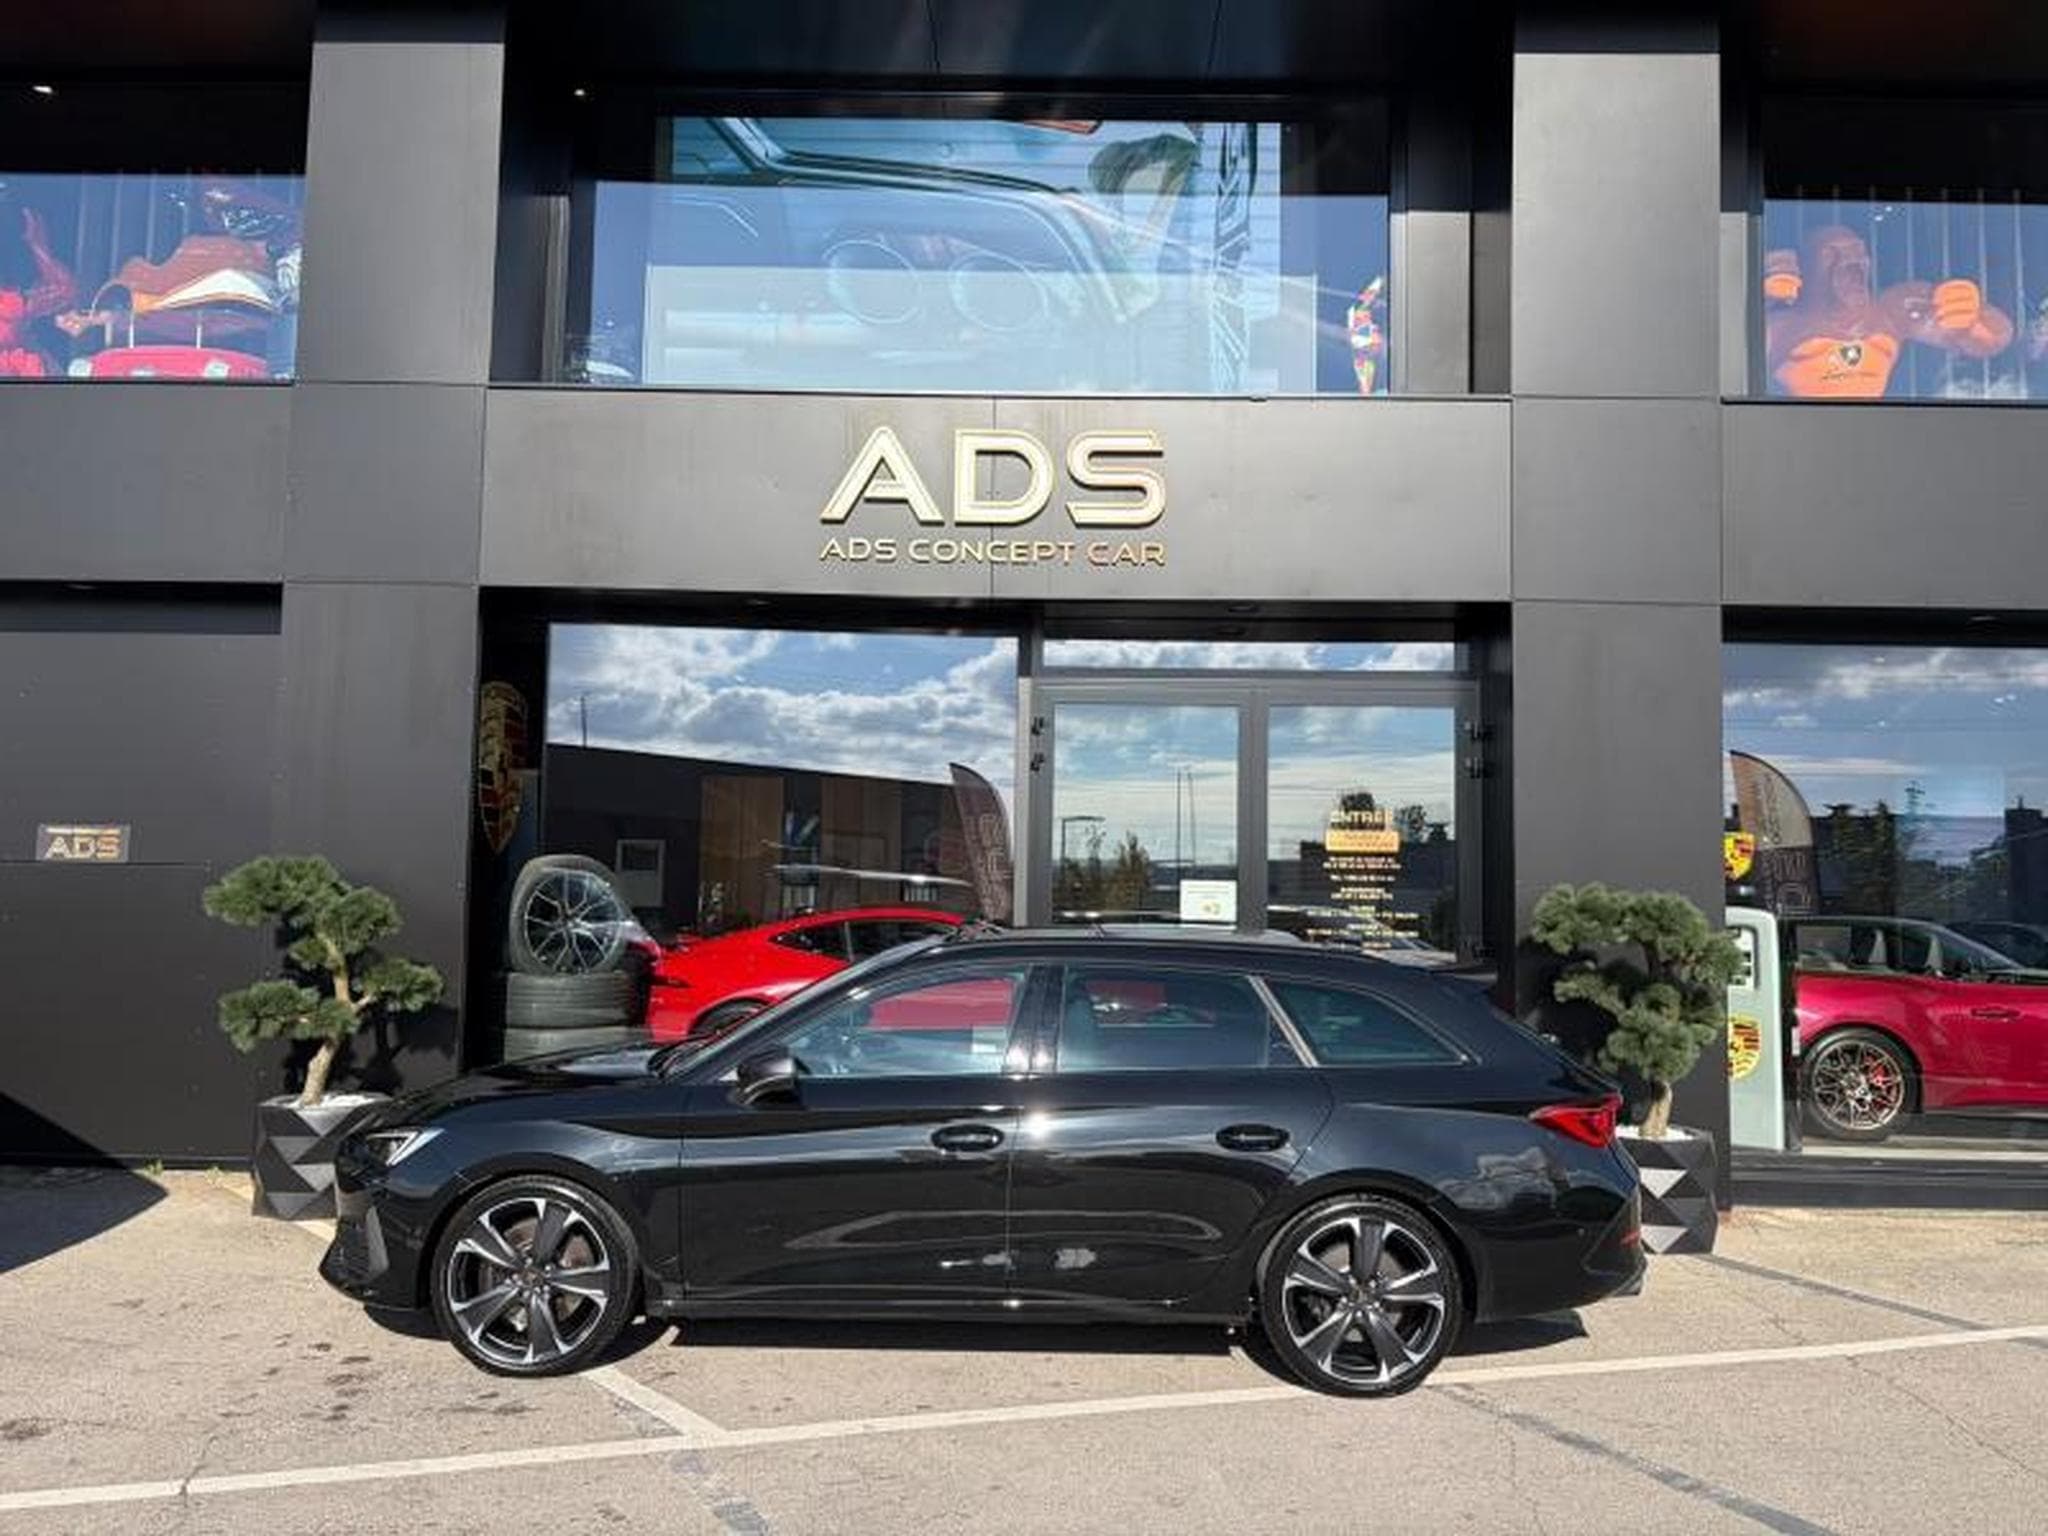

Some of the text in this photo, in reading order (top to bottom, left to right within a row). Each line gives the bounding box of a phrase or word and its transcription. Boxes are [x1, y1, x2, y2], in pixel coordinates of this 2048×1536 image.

[820, 426, 1166, 529] ADS
[819, 538, 1166, 566] ADS CONCEPT CAR
[45, 835, 121, 859] ADS
